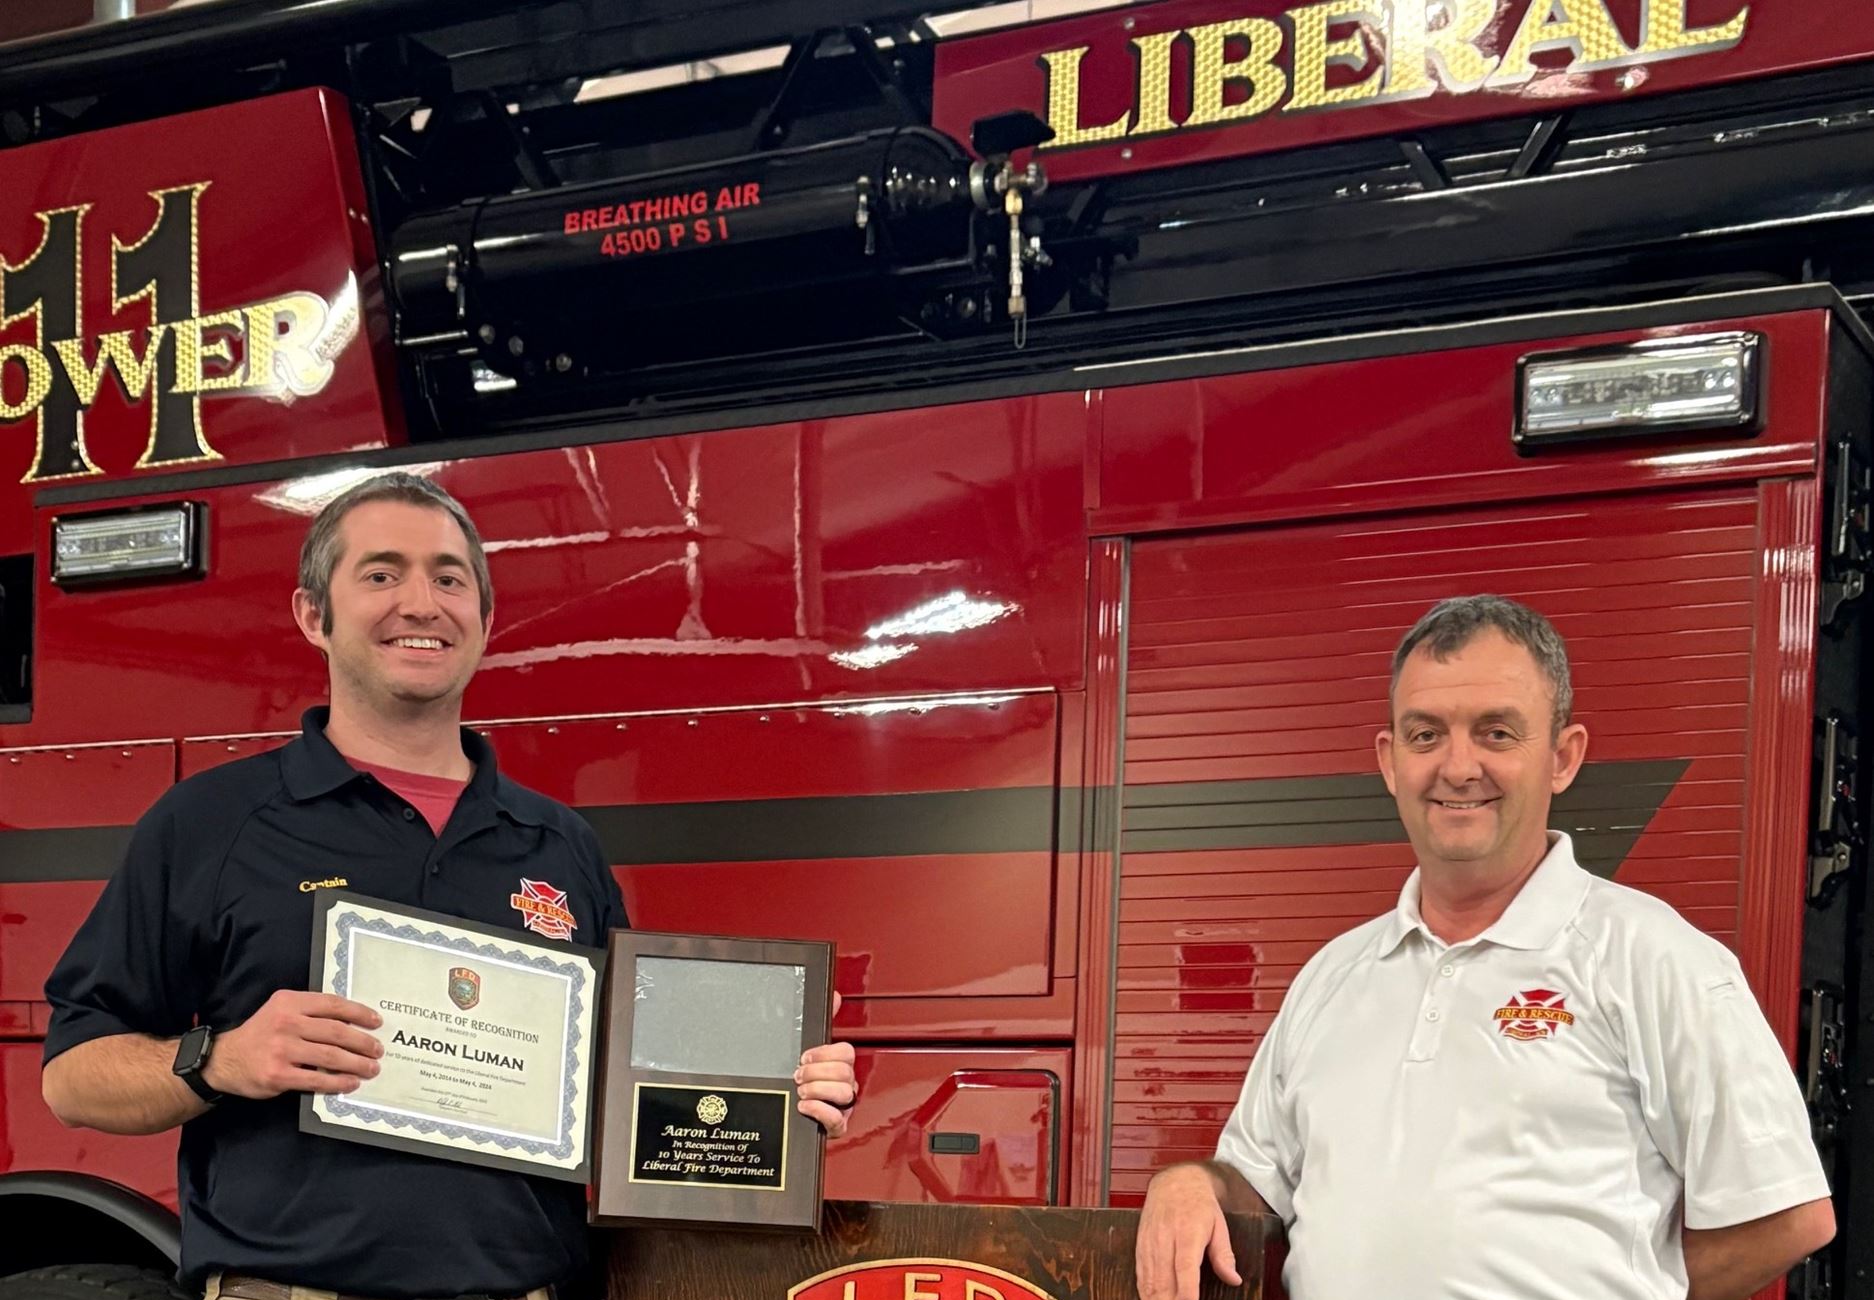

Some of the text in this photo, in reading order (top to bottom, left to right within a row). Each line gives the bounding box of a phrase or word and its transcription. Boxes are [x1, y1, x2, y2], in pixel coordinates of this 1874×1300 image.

[1038, 0, 1749, 149] LIBERAL
[564, 182, 761, 234] BREATHING AIR
[600, 228, 661, 257] 4500
[0, 181, 224, 484] 11
[379, 1000, 540, 1044] CERTIFICATE OF RECOGNITION
[1497, 1008, 1519, 1018] FIRE
[1530, 1009, 1573, 1025] RESCUE
[392, 1030, 524, 1072] AARON LUMAN
[420, 1070, 432, 1079] May
[459, 1078, 471, 1087] May
[661, 1124, 760, 1141] Aaron Luman
[658, 1150, 761, 1164] 10 Years Service To
[672, 1140, 749, 1153] In Recognition Of
[642, 1160, 775, 1177] Liberal Fire Department
